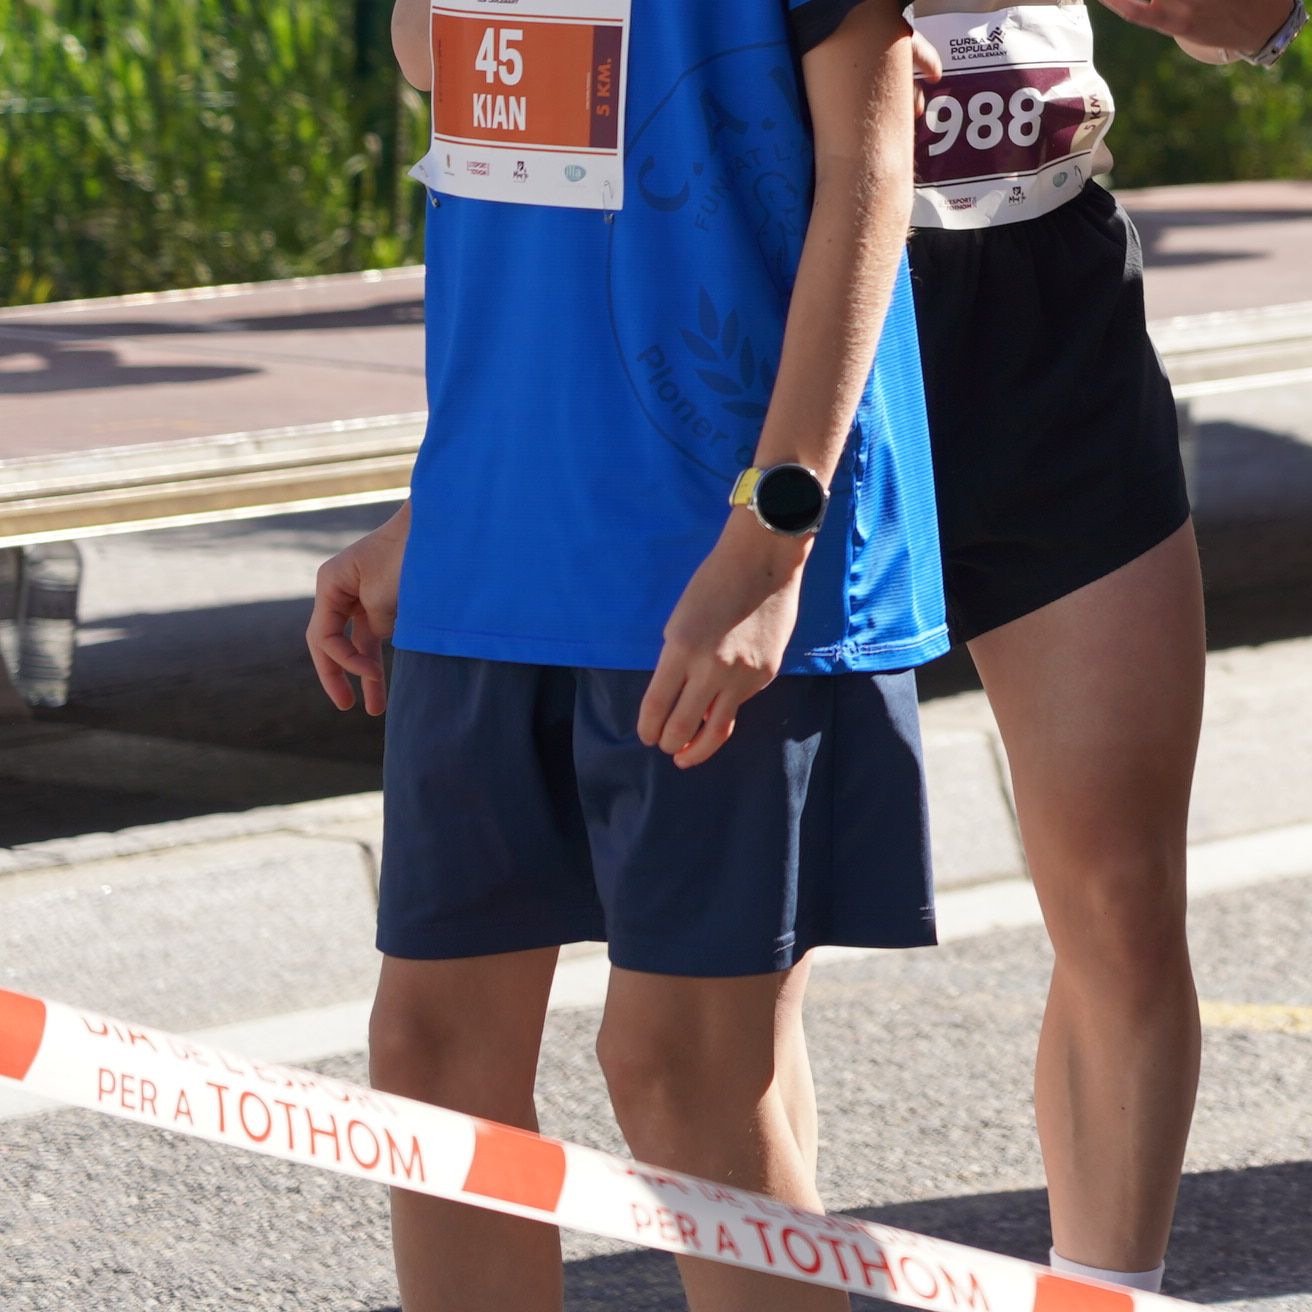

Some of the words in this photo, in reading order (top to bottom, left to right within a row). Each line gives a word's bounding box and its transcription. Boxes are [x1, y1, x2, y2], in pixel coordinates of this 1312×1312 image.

[474, 28, 524, 86] 45
[950, 37, 985, 48] CURSA
[951, 43, 1000, 55] POPULAR
[597, 58, 611, 97] KM.
[472, 93, 527, 131] KIAN
[597, 104, 610, 117] 5
[925, 87, 1045, 157] 988
[97, 1067, 158, 1116] PER
[174, 1088, 194, 1126] A
[206, 1081, 425, 1183] TOTHOM
[629, 1201, 701, 1250] PER
[716, 1223, 742, 1260] A
[744, 1215, 990, 1312] TOTHOM
